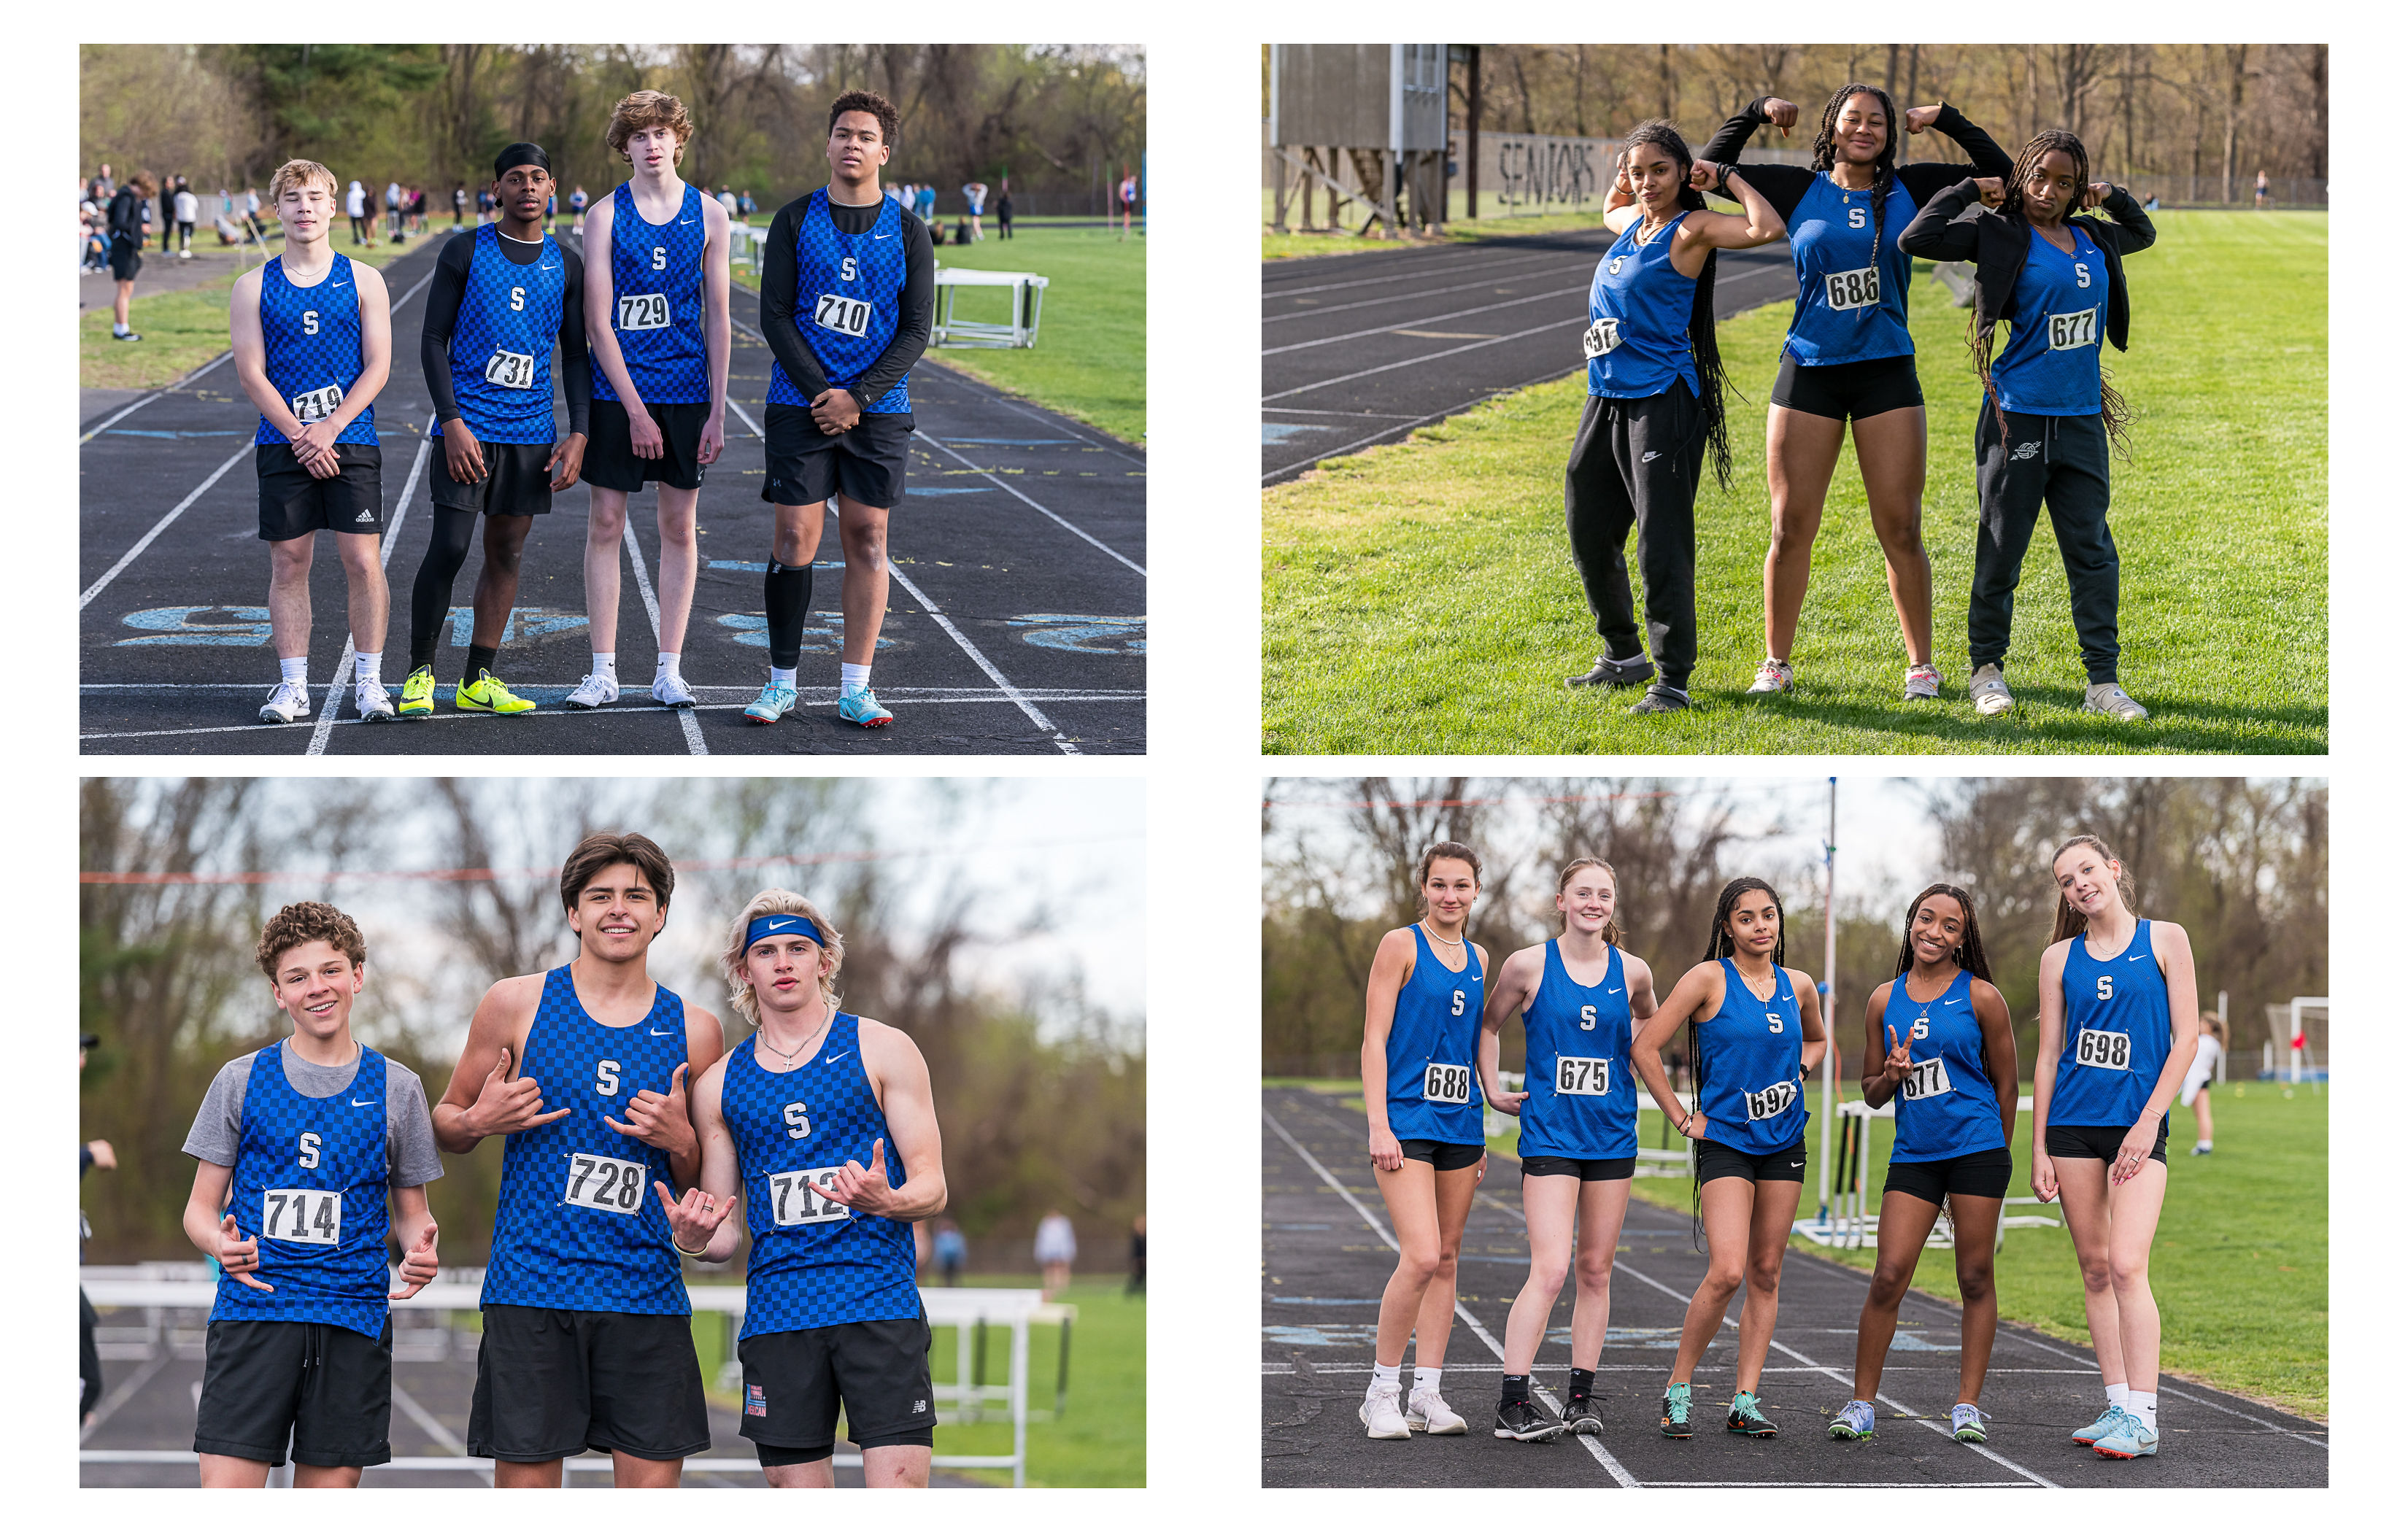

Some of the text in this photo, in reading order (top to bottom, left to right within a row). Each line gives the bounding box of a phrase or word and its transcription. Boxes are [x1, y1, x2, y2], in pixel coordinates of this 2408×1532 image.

[1498, 142, 1595, 205] SENIORS
[1847, 207, 1867, 229] S
[651, 246, 667, 271] S
[840, 256, 857, 282] S
[1608, 255, 1629, 276] S
[1829, 271, 1879, 307] 686
[2074, 262, 2091, 289] S
[510, 285, 526, 312] S
[621, 296, 666, 328] 729
[817, 296, 866, 333] 710
[303, 309, 320, 336] S
[2053, 311, 2094, 347] 677
[487, 352, 531, 385] 731
[296, 387, 341, 420] 719
[1451, 989, 1467, 1017] S
[2096, 974, 2114, 1001] S
[1579, 1004, 1598, 1031] S
[1765, 1013, 1785, 1034] S
[1913, 1017, 1931, 1040] S
[2080, 1032, 2128, 1067] 698
[595, 1059, 622, 1097] S
[1427, 1066, 1468, 1100] 688
[1560, 1060, 1606, 1092] 675
[1750, 1085, 1791, 1118] 697
[783, 1100, 812, 1141] S
[298, 1131, 323, 1169] S
[570, 1158, 640, 1210] 728
[773, 1172, 844, 1221] 712
[268, 1194, 336, 1239] 714
